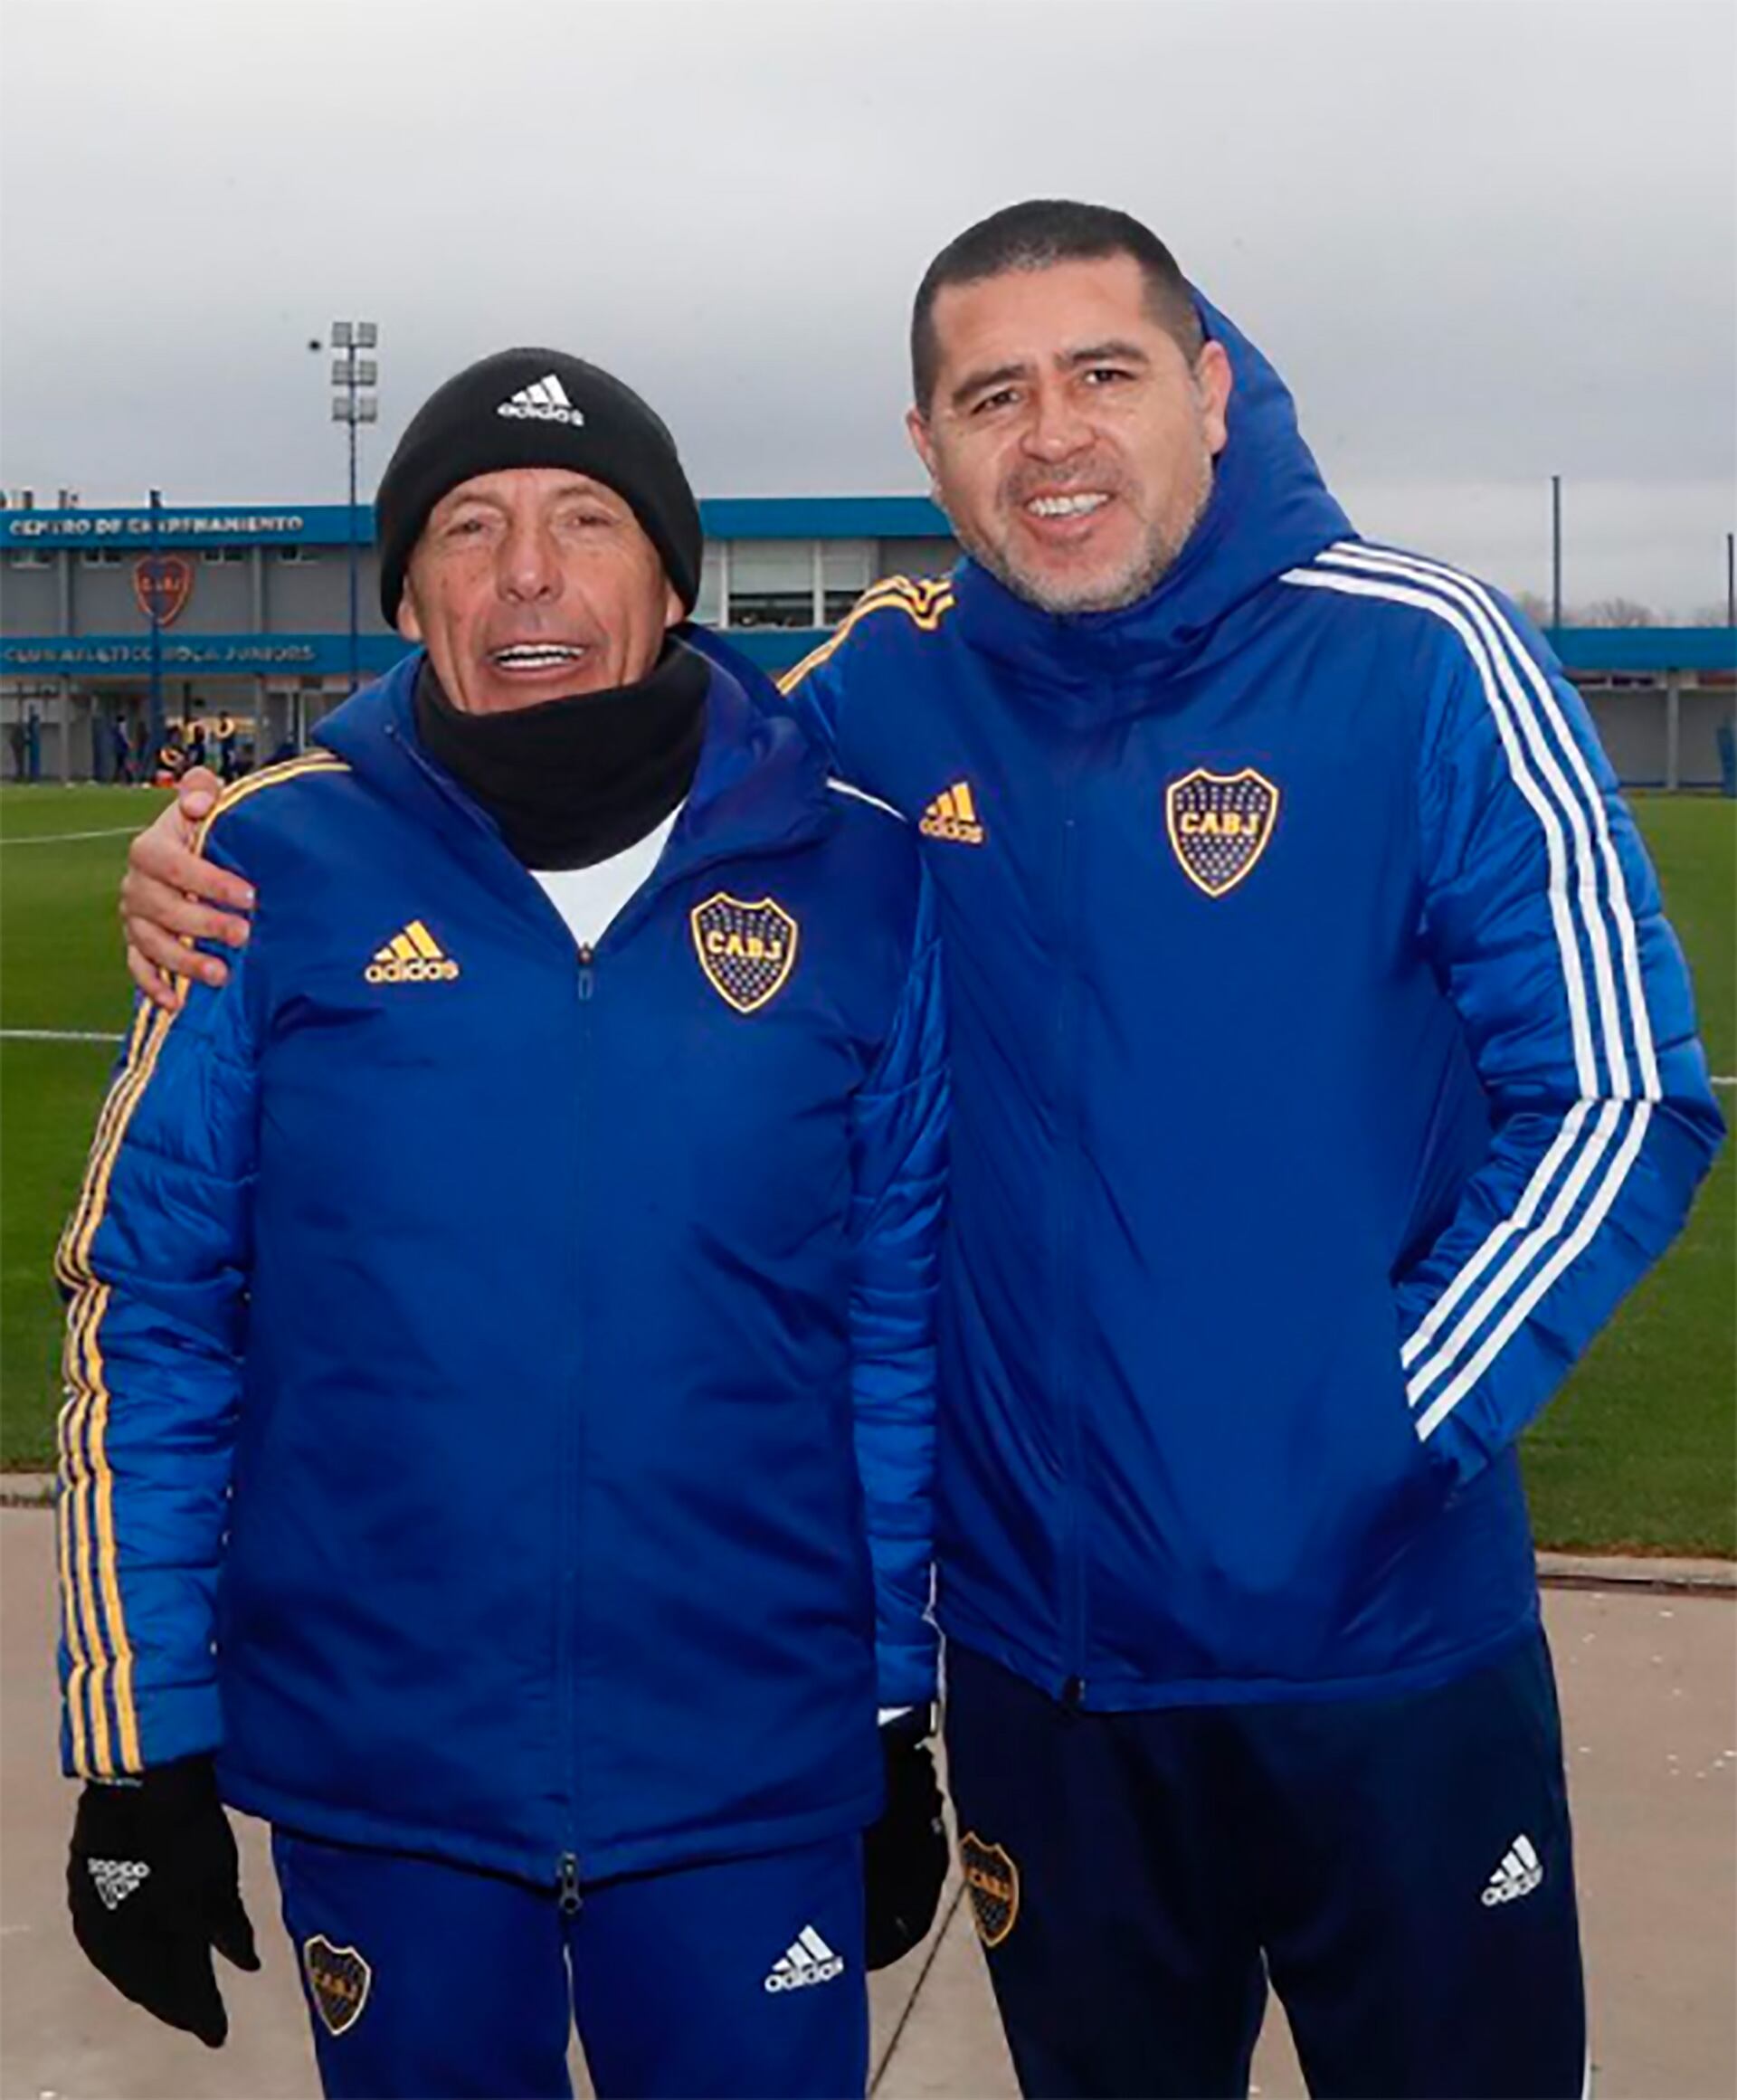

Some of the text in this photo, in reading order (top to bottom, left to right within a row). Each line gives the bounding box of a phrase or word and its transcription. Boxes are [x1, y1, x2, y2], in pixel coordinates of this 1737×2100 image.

[497, 402, 584, 427] adidas
[918, 815, 982, 843] adidas
[1181, 812, 1260, 835] CABJ
[707, 930, 782, 960] CABJ
[364, 957, 459, 983] adidas
[764, 1955, 844, 1993] adidas
